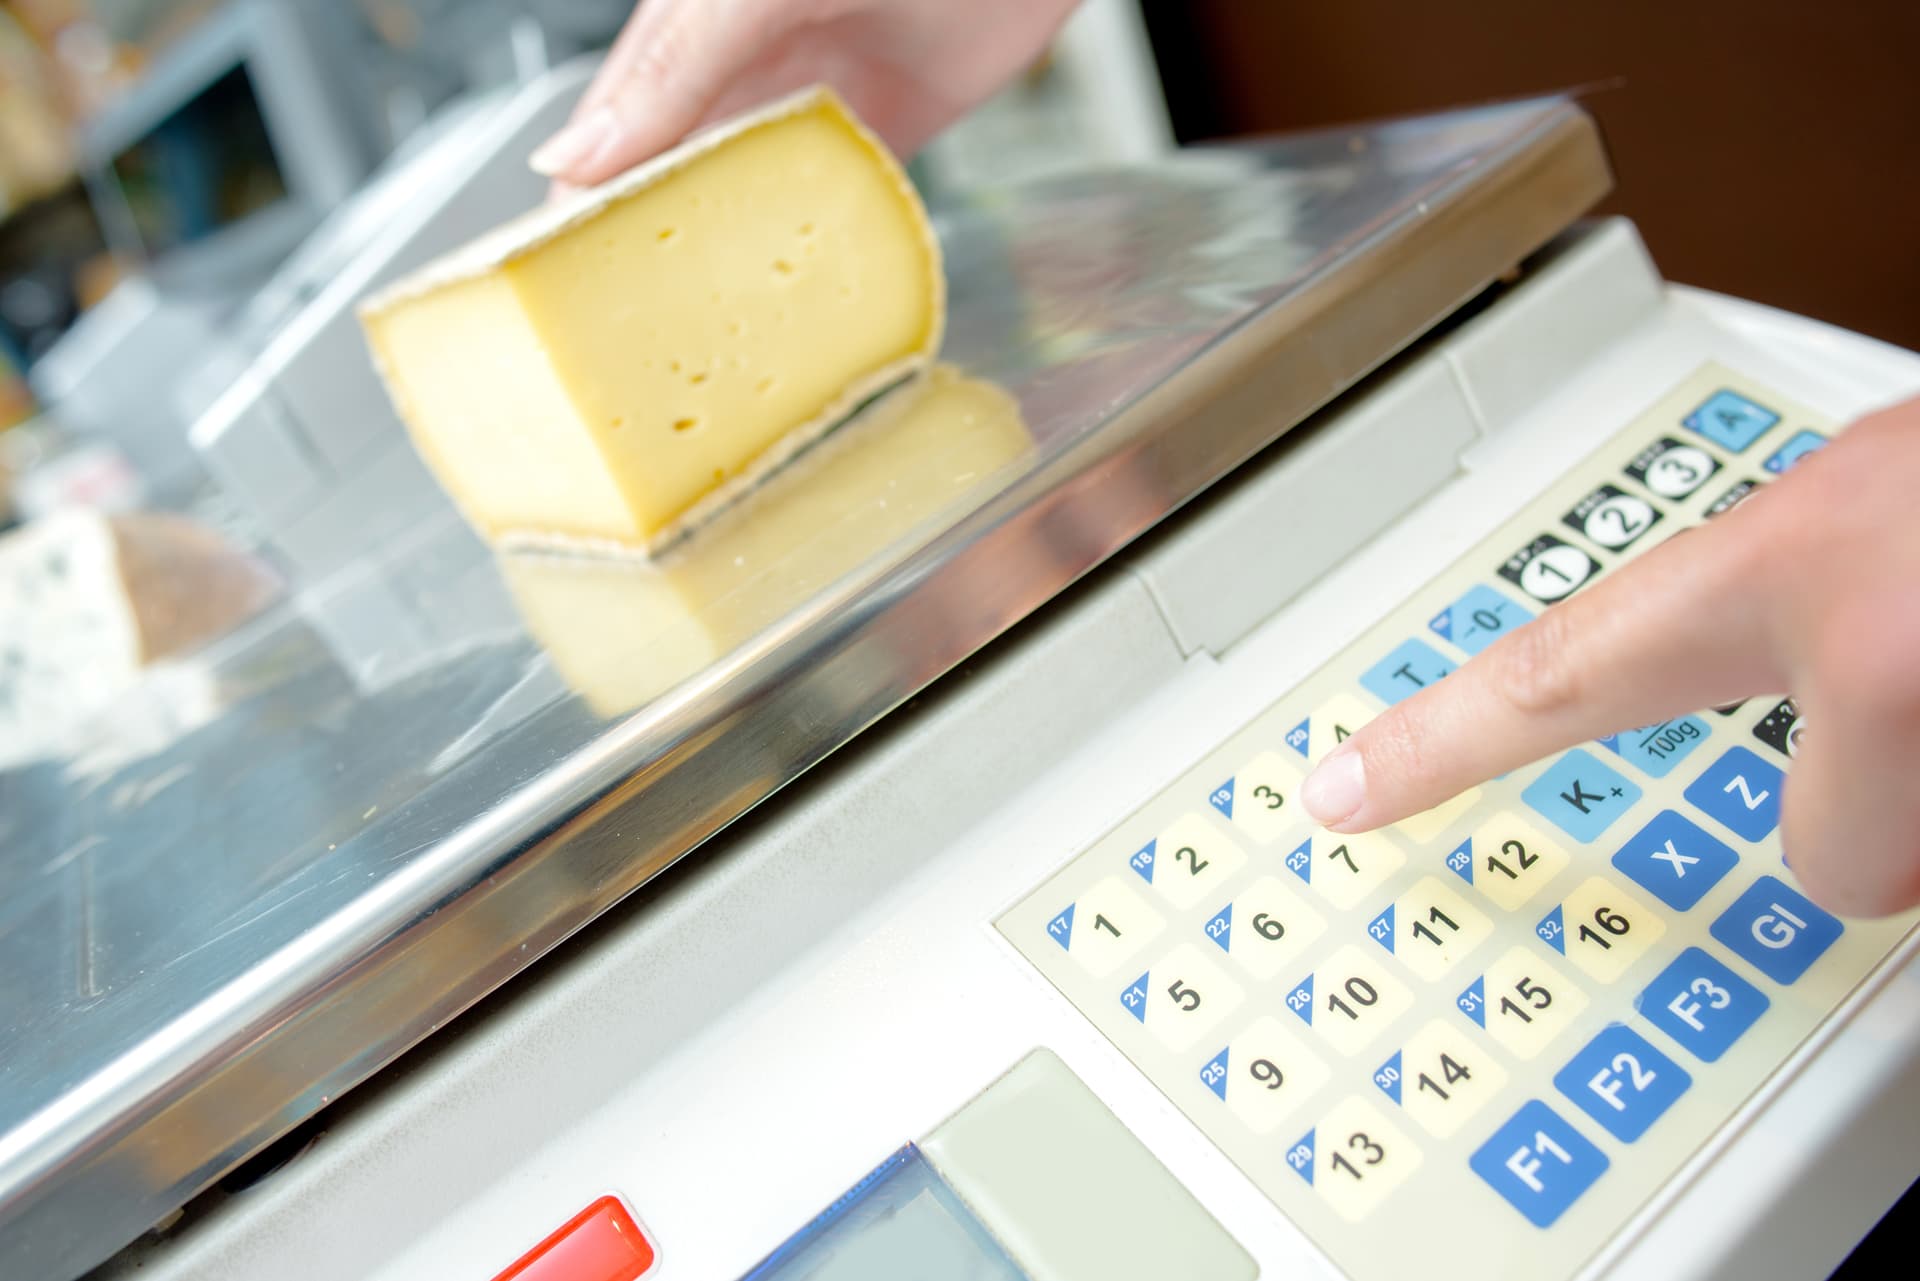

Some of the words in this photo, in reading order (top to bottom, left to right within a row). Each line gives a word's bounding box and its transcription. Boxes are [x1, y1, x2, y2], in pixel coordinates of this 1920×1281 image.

[1661, 459, 1698, 482] 3
[1602, 508, 1641, 533] 2
[1538, 562, 1572, 583] 1
[1288, 729, 1307, 746] 20
[1648, 721, 1700, 759] 100g
[1212, 790, 1231, 806] 19
[1254, 785, 1284, 809] 3
[1723, 775, 1769, 810] Z
[1132, 852, 1152, 870] 18
[1175, 847, 1209, 876] 2
[1288, 851, 1309, 870] 23
[1329, 844, 1359, 873] 7
[1448, 851, 1470, 871] 28
[1488, 840, 1539, 880] 12
[1650, 839, 1701, 878] X
[1050, 917, 1069, 935] 17
[1094, 913, 1121, 937] 1
[1207, 917, 1230, 938] 22
[1252, 913, 1285, 941] 6
[1371, 918, 1391, 939] 27
[1413, 906, 1460, 946] 11
[1538, 920, 1562, 939] 32
[1579, 907, 1630, 950] 16
[1125, 987, 1145, 1007] 21
[1168, 979, 1201, 1011] 5
[1287, 988, 1312, 1009] 26
[1328, 976, 1378, 1020] 10
[1459, 991, 1483, 1012] 31
[1500, 976, 1553, 1023] 15
[1667, 977, 1731, 1032] F3
[1202, 1062, 1226, 1085] 25
[1249, 1058, 1284, 1090] 9
[1375, 1066, 1400, 1089] 30
[1418, 1052, 1471, 1100] 14
[1588, 1052, 1657, 1111] F2
[1287, 1144, 1313, 1168] 29
[1331, 1132, 1385, 1180] 13
[1505, 1131, 1573, 1193] F1
